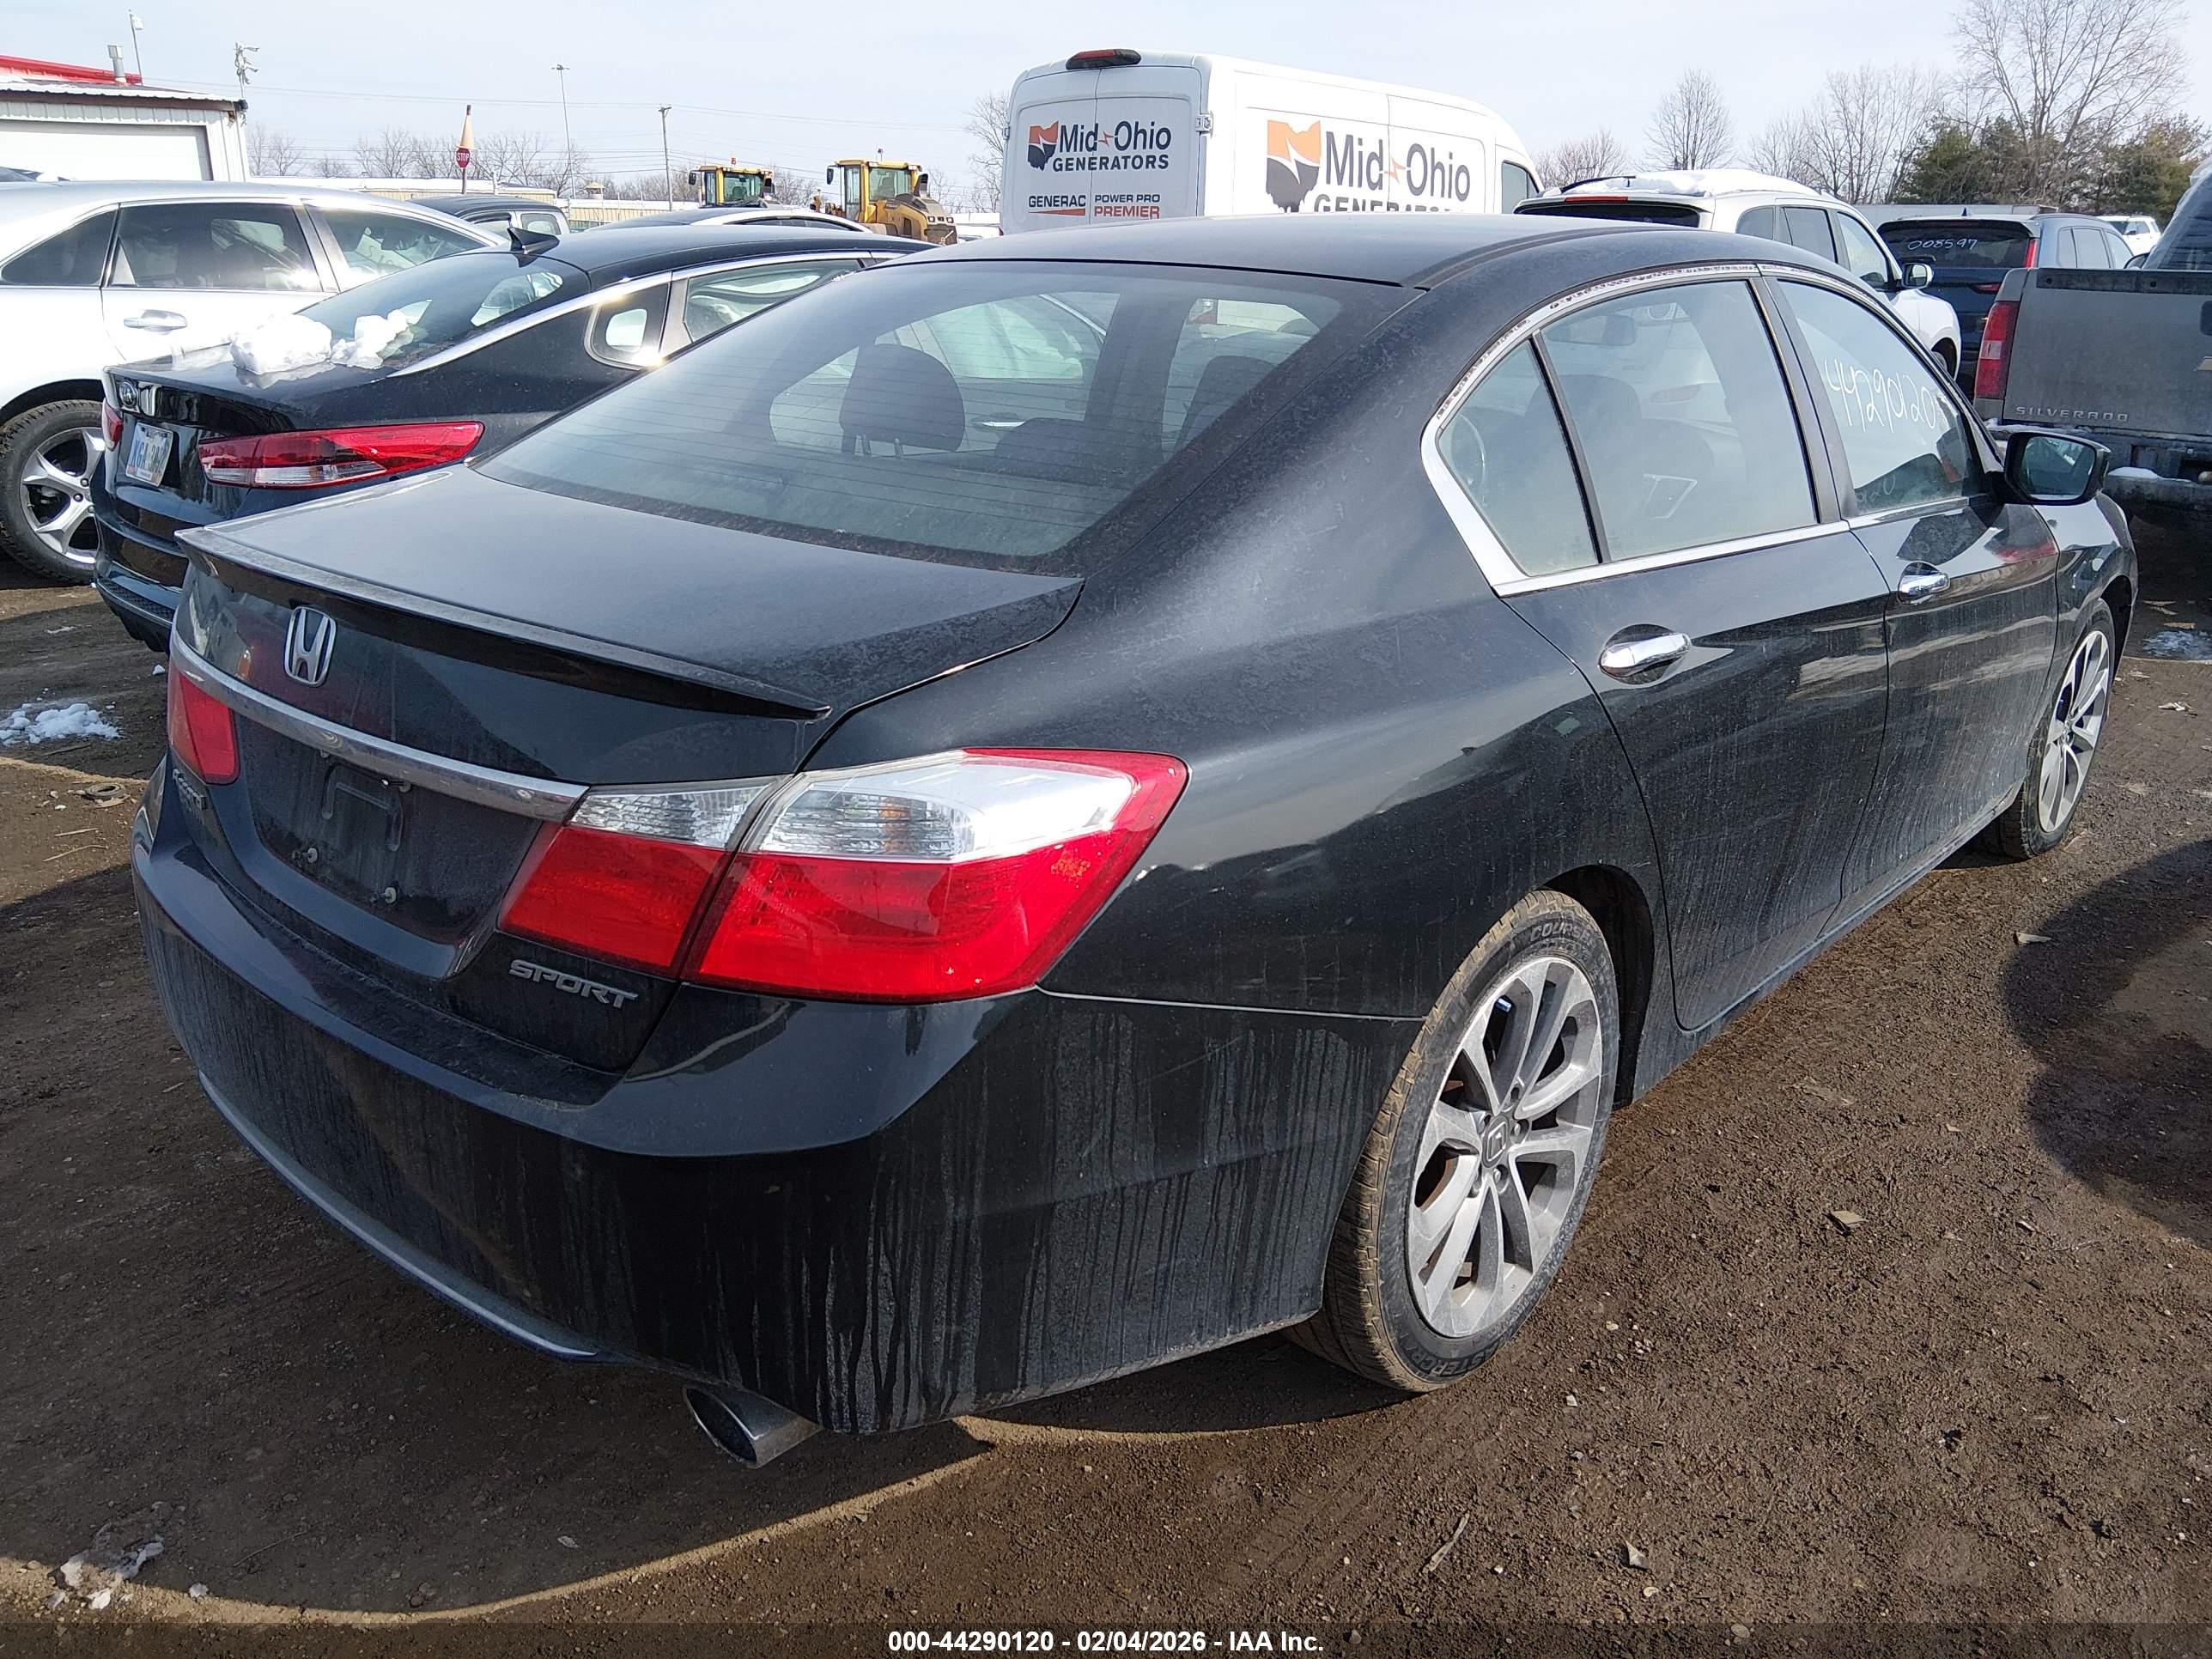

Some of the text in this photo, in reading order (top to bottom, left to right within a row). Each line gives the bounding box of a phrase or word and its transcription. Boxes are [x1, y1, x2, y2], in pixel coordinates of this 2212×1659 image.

[457, 152, 470, 162] STOP
[1052, 154, 1169, 173] GENERATORS
[1028, 194, 1086, 208] GENERAC
[1094, 193, 1161, 204] POWER PRO
[1093, 205, 1160, 220] PREMIER
[1907, 238, 1978, 251] 008597
[1824, 358, 1936, 434] 44290120
[2015, 406, 2128, 422] SILVERADO
[508, 959, 639, 1009] SPORT
